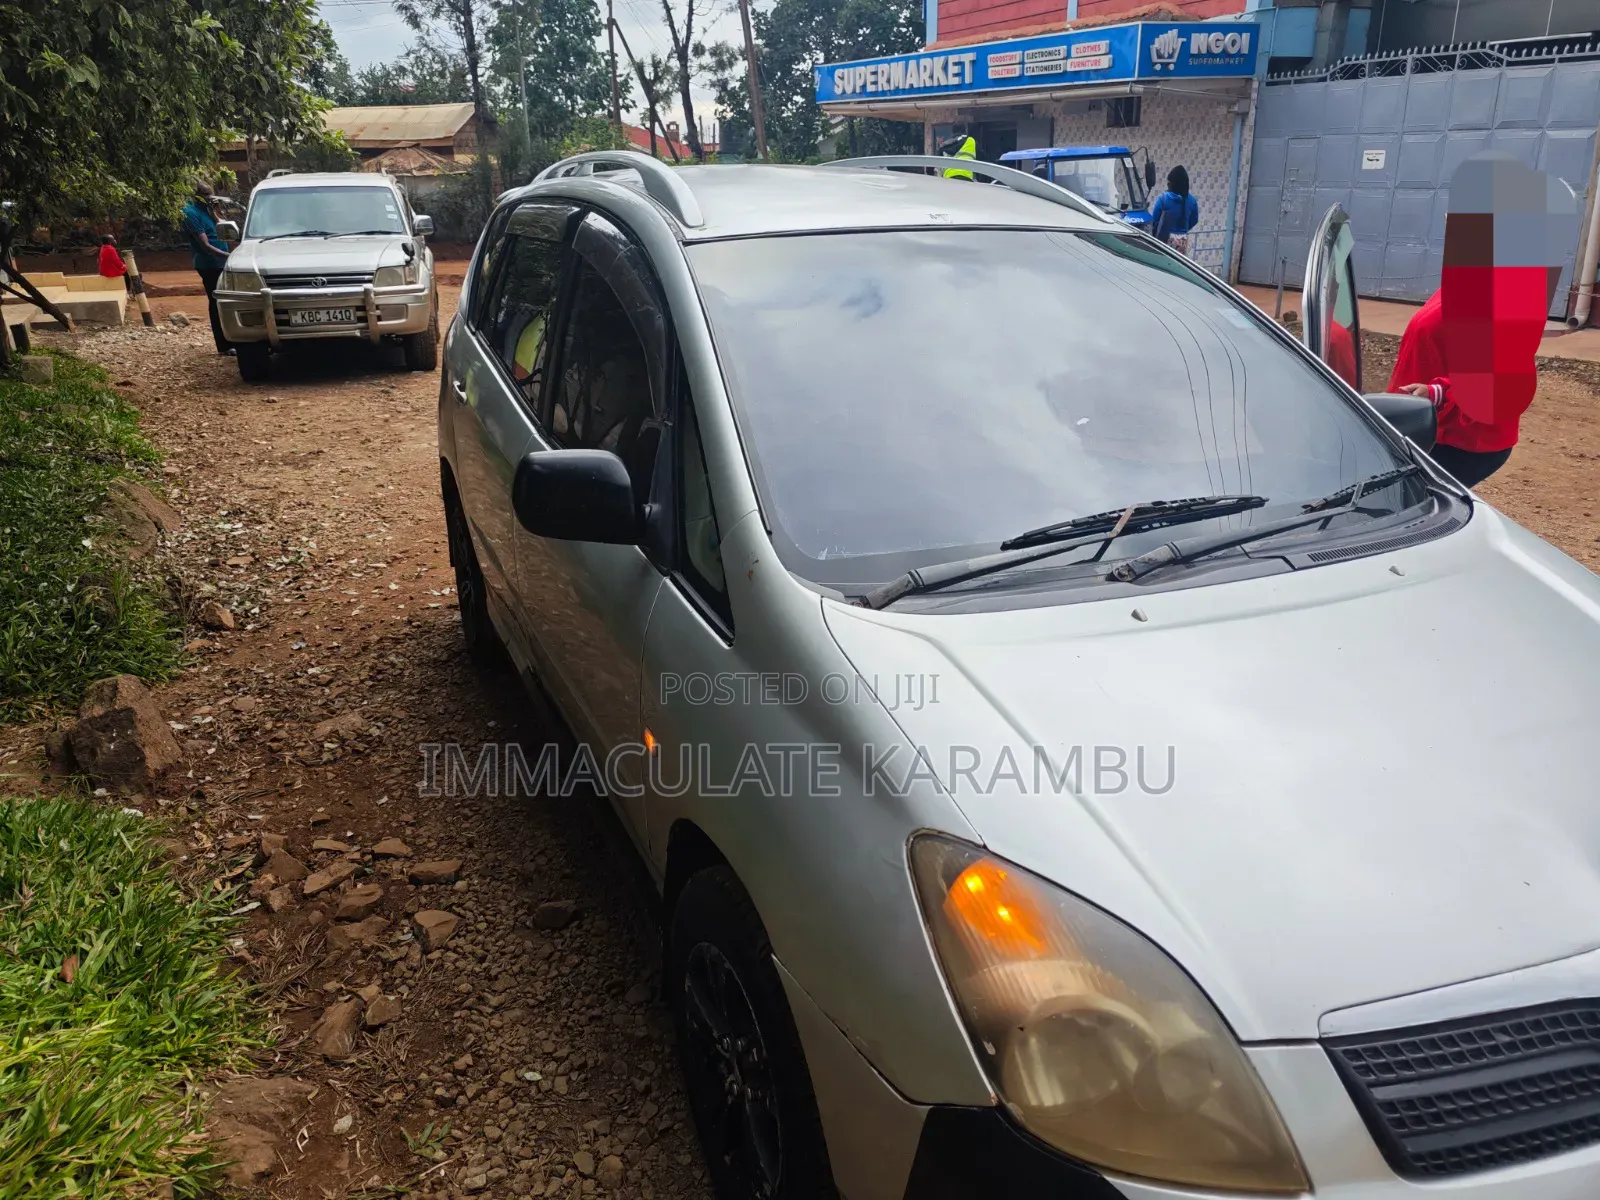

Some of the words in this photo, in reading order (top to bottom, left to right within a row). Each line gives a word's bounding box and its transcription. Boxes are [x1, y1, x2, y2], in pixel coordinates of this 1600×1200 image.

[1190, 32, 1251, 54] NGOI
[1026, 48, 1062, 60] ELECTRONICS
[1075, 44, 1101, 54] CLOTHES
[1070, 59, 1101, 69] FURNITURE
[1188, 57, 1245, 66] SUPERMARKET
[834, 52, 976, 94] SUPERMARKET
[1025, 64, 1062, 74] STATIONERIES
[300, 311, 321, 323] KBC
